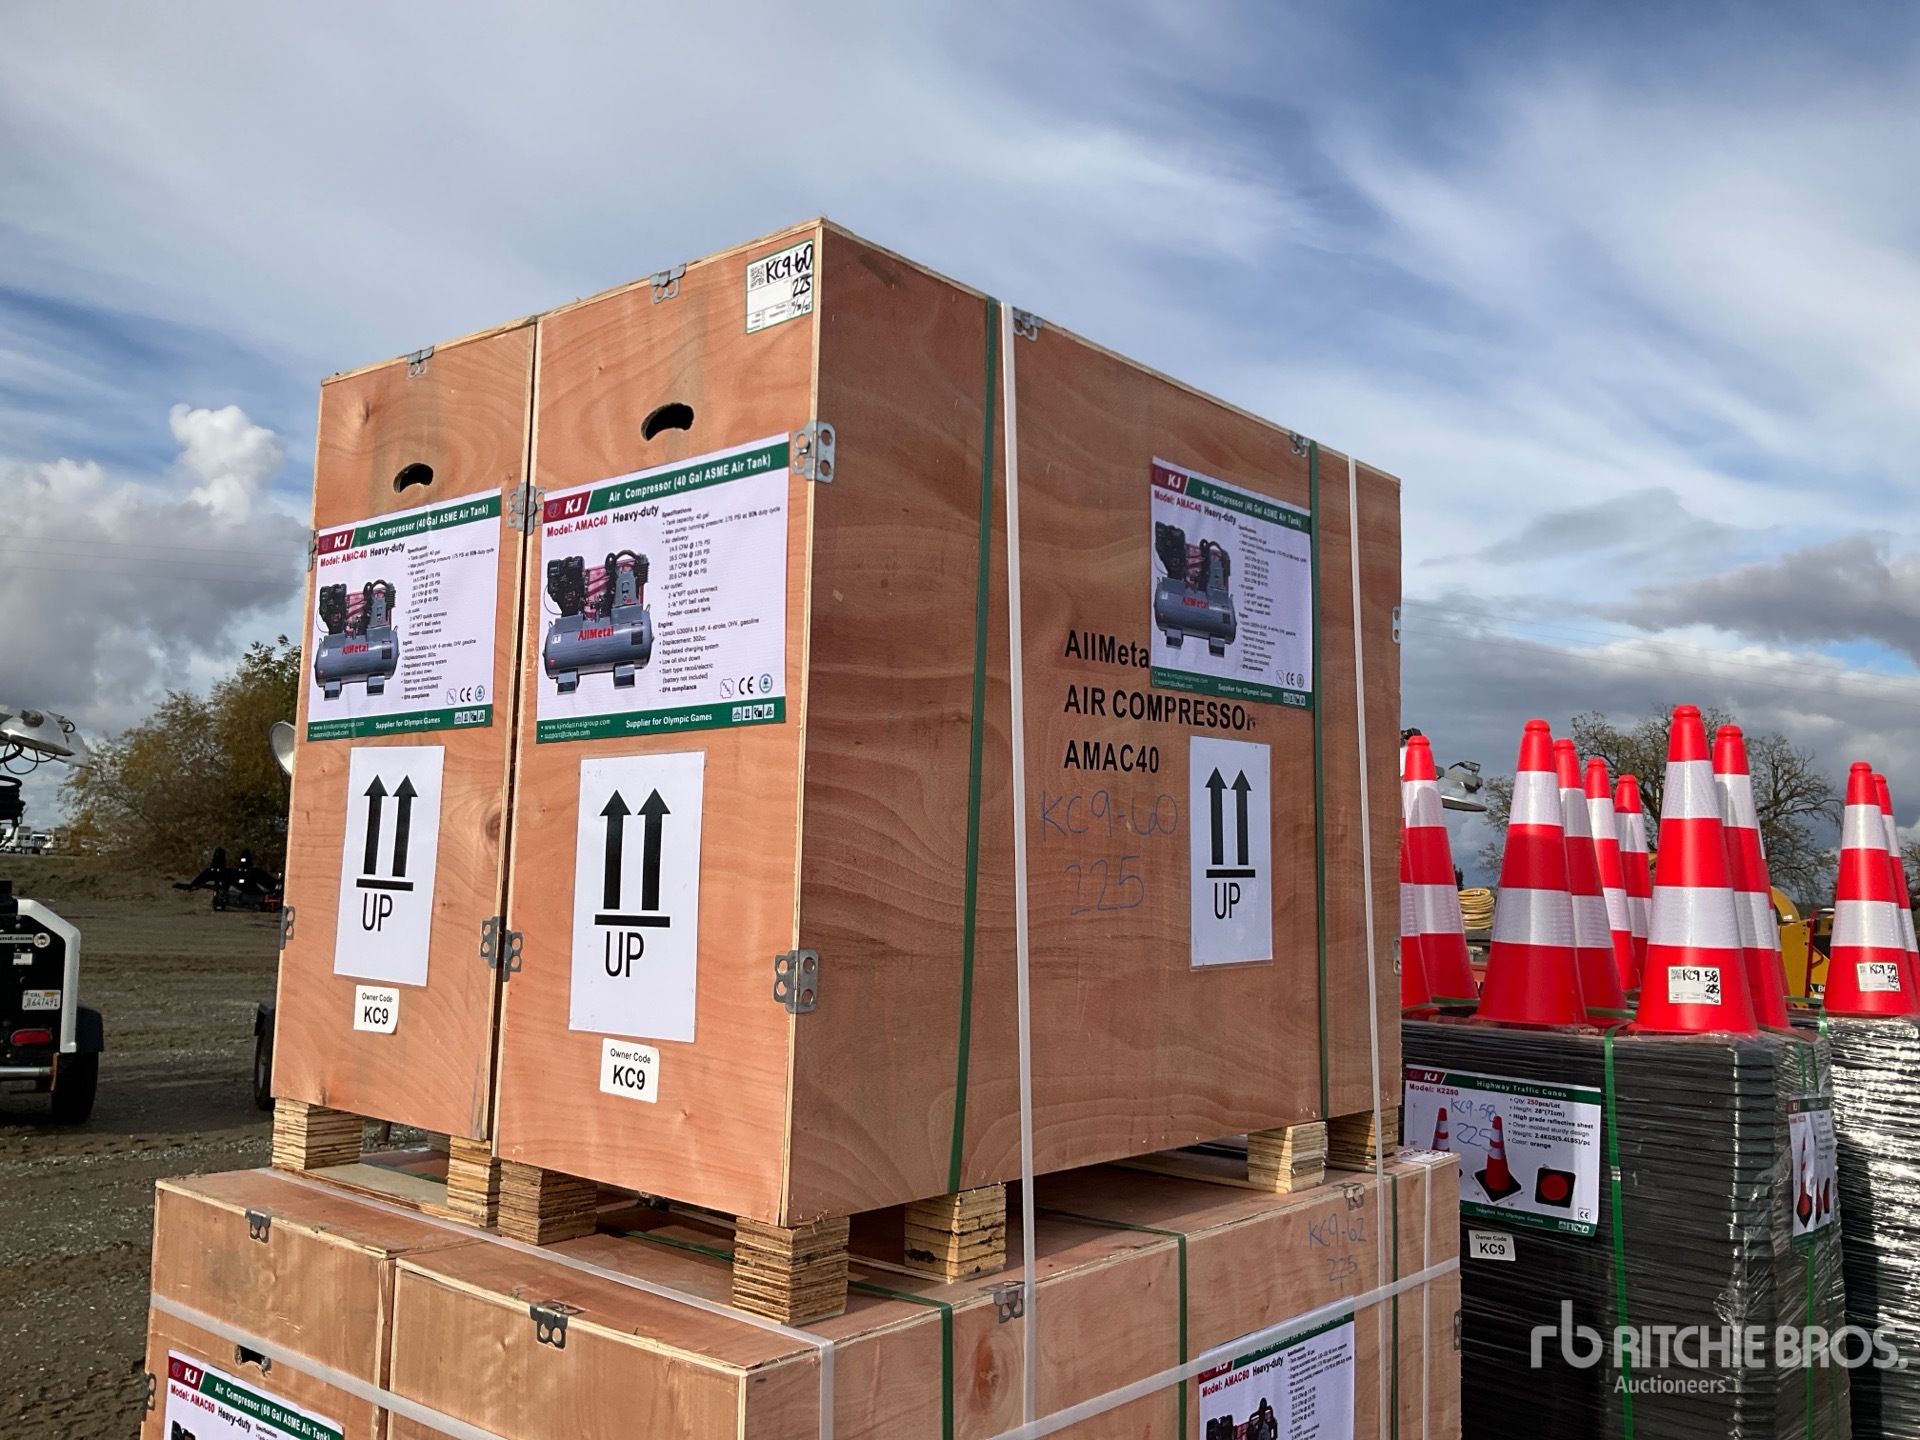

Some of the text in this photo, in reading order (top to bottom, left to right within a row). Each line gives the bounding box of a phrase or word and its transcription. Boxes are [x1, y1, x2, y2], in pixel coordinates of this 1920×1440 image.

[793, 276, 811, 298] 225
[609, 454, 770, 503] Air Compressor (40 Gal ASME Air Tank)
[1168, 474, 1181, 488] KJ
[1201, 487, 1209, 497] Air
[1212, 490, 1242, 508] Compressor
[565, 498, 582, 514] KJ
[1154, 489, 1175, 505] Model:
[1204, 505, 1236, 526] Heavy-duty
[368, 530, 377, 539] Air
[380, 522, 415, 536] Compressor
[426, 516, 437, 526] Gal
[439, 511, 457, 524] ASME
[459, 510, 469, 519] Air
[470, 504, 488, 516] Tank)
[547, 505, 659, 537] Model: AMAC40 Heavy-duty
[334, 534, 348, 548] KJ
[320, 557, 340, 567] Model:
[370, 543, 405, 557] Heavy-duty
[740, 618, 760, 627] gasoline
[578, 626, 614, 641] AllMetal
[342, 644, 369, 655] AllMetal
[662, 648, 684, 656] Regulated
[684, 645, 703, 653] charging
[1064, 630, 1149, 668] AllMeta
[672, 684, 697, 692] compliance
[1218, 684, 1234, 692] Supplier
[1064, 685, 1106, 717] AIR
[404, 718, 422, 727] Olympic
[626, 713, 712, 729] Supplier for Olympic Games
[1064, 740, 1160, 774] AMAC40
[1064, 854, 1144, 915] 225
[1214, 882, 1240, 919] UP
[362, 892, 393, 932] UP
[604, 931, 645, 978] UP
[1683, 969, 1718, 982] KC9 58
[1870, 964, 1885, 974] KC9
[1706, 984, 1719, 993] 225
[362, 992, 392, 1002] Owner Code
[364, 1006, 388, 1024] KC9
[610, 1048, 651, 1064] Owner Code
[613, 1065, 645, 1090] KC9
[1424, 1072, 1438, 1081] KJ
[1409, 1084, 1434, 1092] Model:
[1476, 1080, 1567, 1097] Highway Traffic Cones
[1527, 1099, 1560, 1109] 250pcs/Lot
[1513, 1122, 1550, 1131] Over-molded
[1551, 1127, 1569, 1135] sturdy
[1547, 1118, 1575, 1127] reflective
[1480, 1243, 1505, 1255] KC9
[1327, 1255, 1357, 1281] 225
[184, 1367, 198, 1385] KJ
[1202, 1380, 1222, 1397] Model:
[1252, 1357, 1284, 1376] Heavy-duty
[170, 1384, 190, 1401] Model:
[217, 1406, 251, 1433] Heavy-duty
[215, 1382, 224, 1394] Air
[226, 1388, 260, 1412] Compressor
[271, 1408, 281, 1421] Gal
[283, 1414, 300, 1430] ASME
[301, 1423, 311, 1435] Air
[312, 1427, 330, 1440] Tank)
